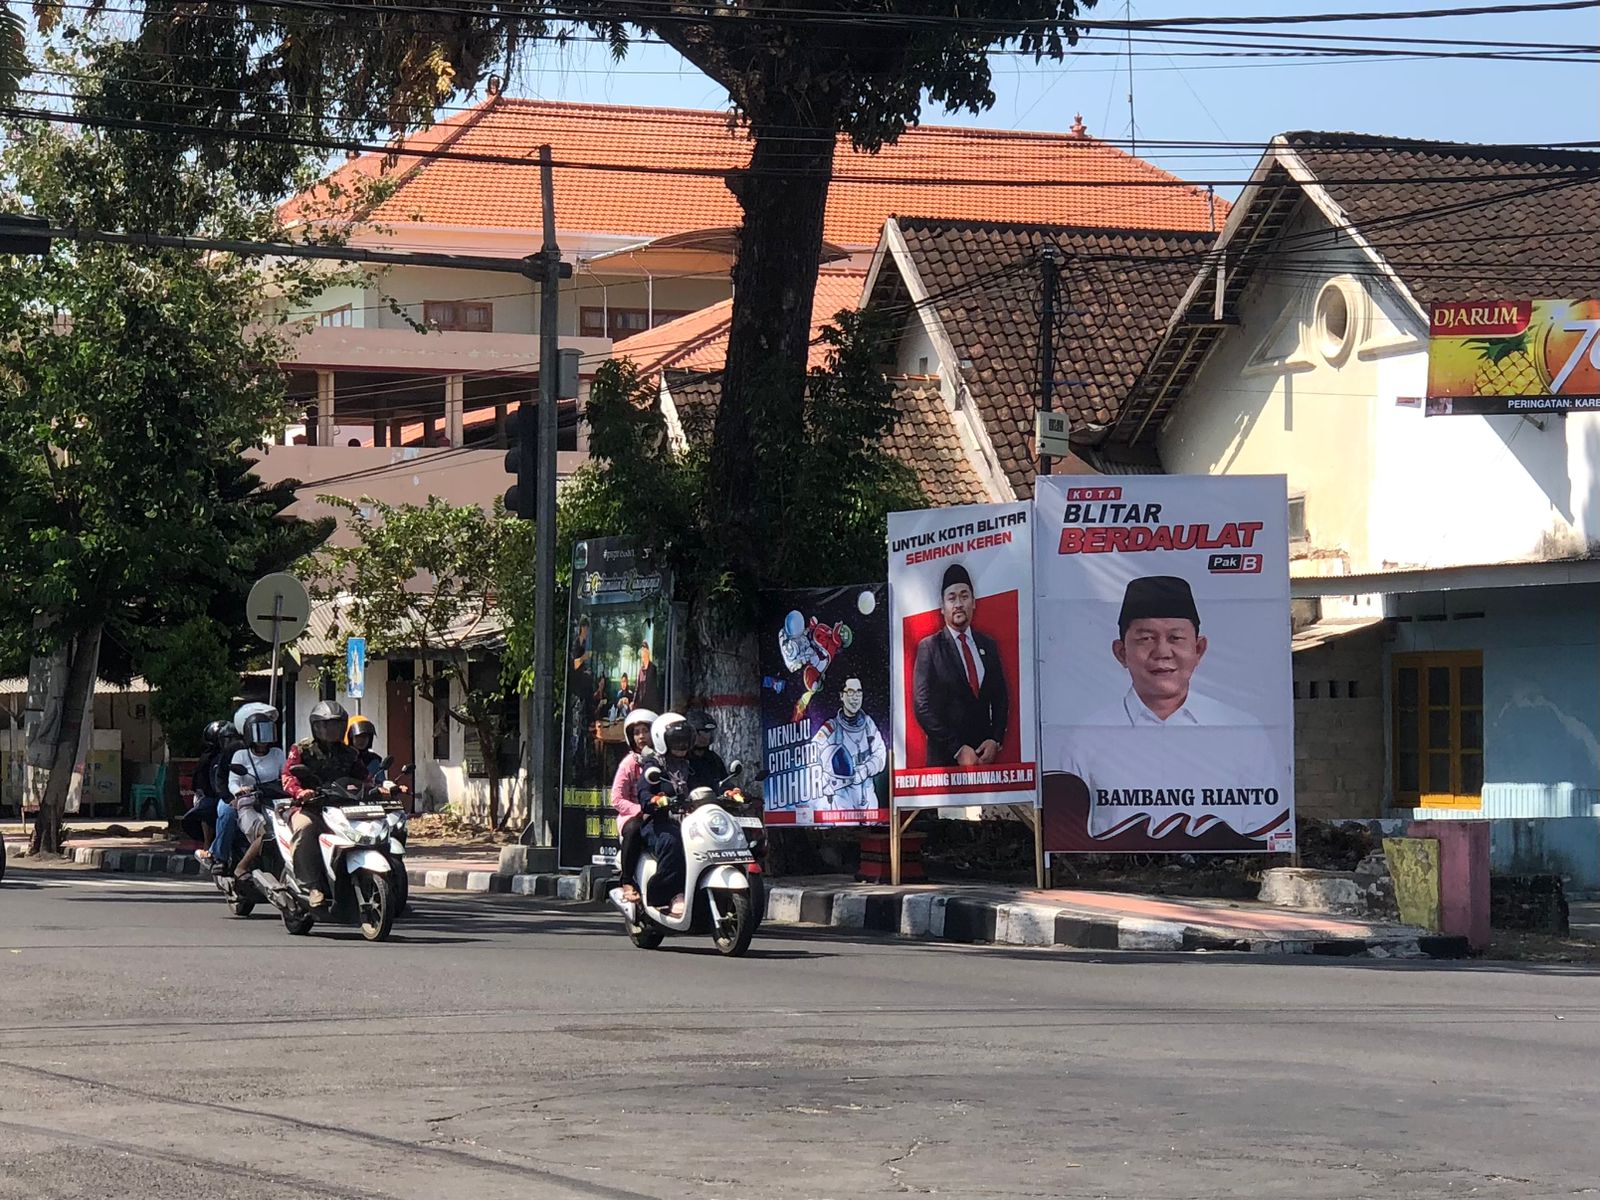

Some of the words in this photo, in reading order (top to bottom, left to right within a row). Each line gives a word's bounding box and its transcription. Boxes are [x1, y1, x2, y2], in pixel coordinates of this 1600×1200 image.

[1434, 306, 1519, 328] DJARUM
[1508, 399, 1573, 409] PERINGATAN:
[1073, 489, 1116, 500] KOTA
[1063, 503, 1163, 524] BLITAR
[892, 532, 936, 553] UNTUK
[938, 523, 975, 542] KOTA
[977, 511, 1027, 533] BLITAR
[1058, 522, 1264, 555] BERDAULAT
[906, 541, 965, 565] SEMAKIN
[967, 531, 1013, 552] KEREN
[1213, 557, 1238, 568] Pak
[1242, 556, 1257, 571] B
[767, 718, 811, 750] MENUJU
[768, 742, 818, 774] CITA-CITA
[769, 764, 823, 811] LUHUR
[895, 774, 920, 789] FREDY
[921, 773, 950, 787] AGUNG
[1096, 788, 1195, 807] BAMBANG
[1201, 788, 1279, 806] RIANTO
